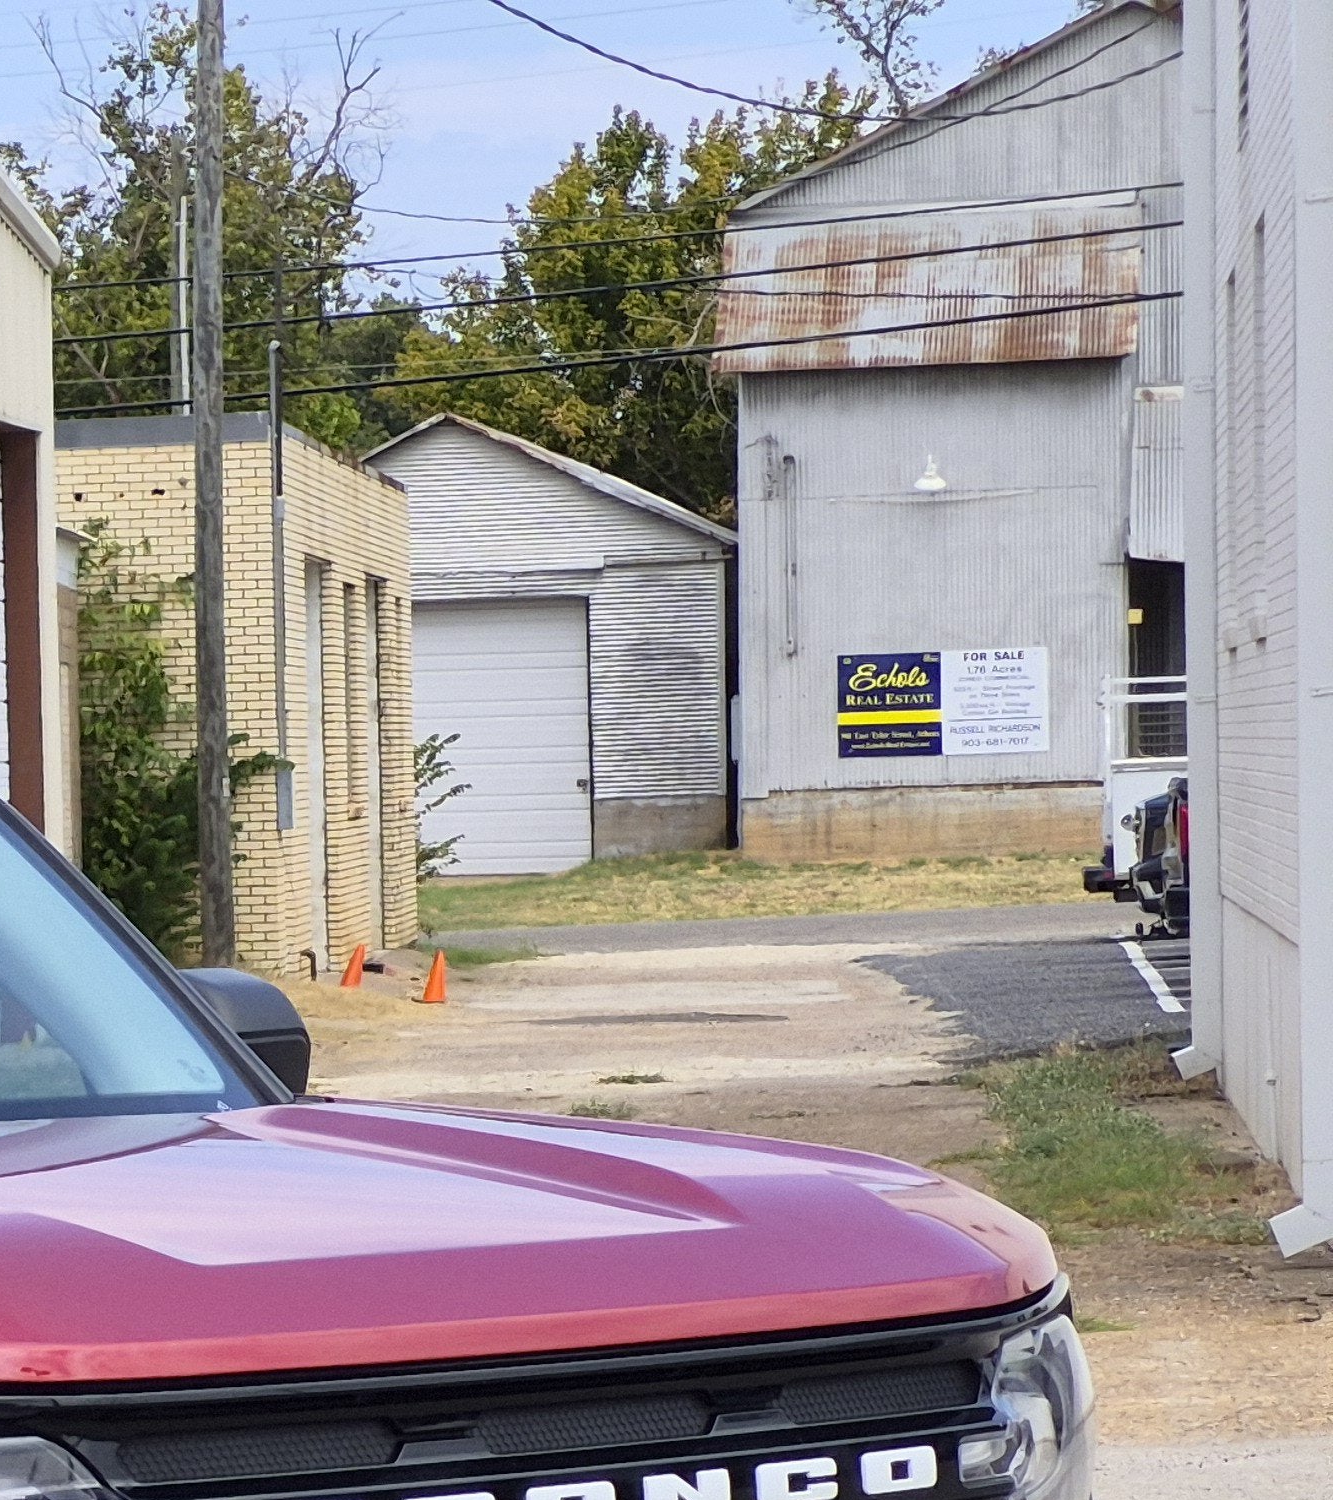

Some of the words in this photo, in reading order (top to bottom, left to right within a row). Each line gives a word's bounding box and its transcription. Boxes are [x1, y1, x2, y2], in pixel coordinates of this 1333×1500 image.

[963, 652, 987, 661] FOR
[994, 650, 1024, 660] SALE
[992, 664, 1022, 673] Acres
[848, 662, 930, 692] Echols
